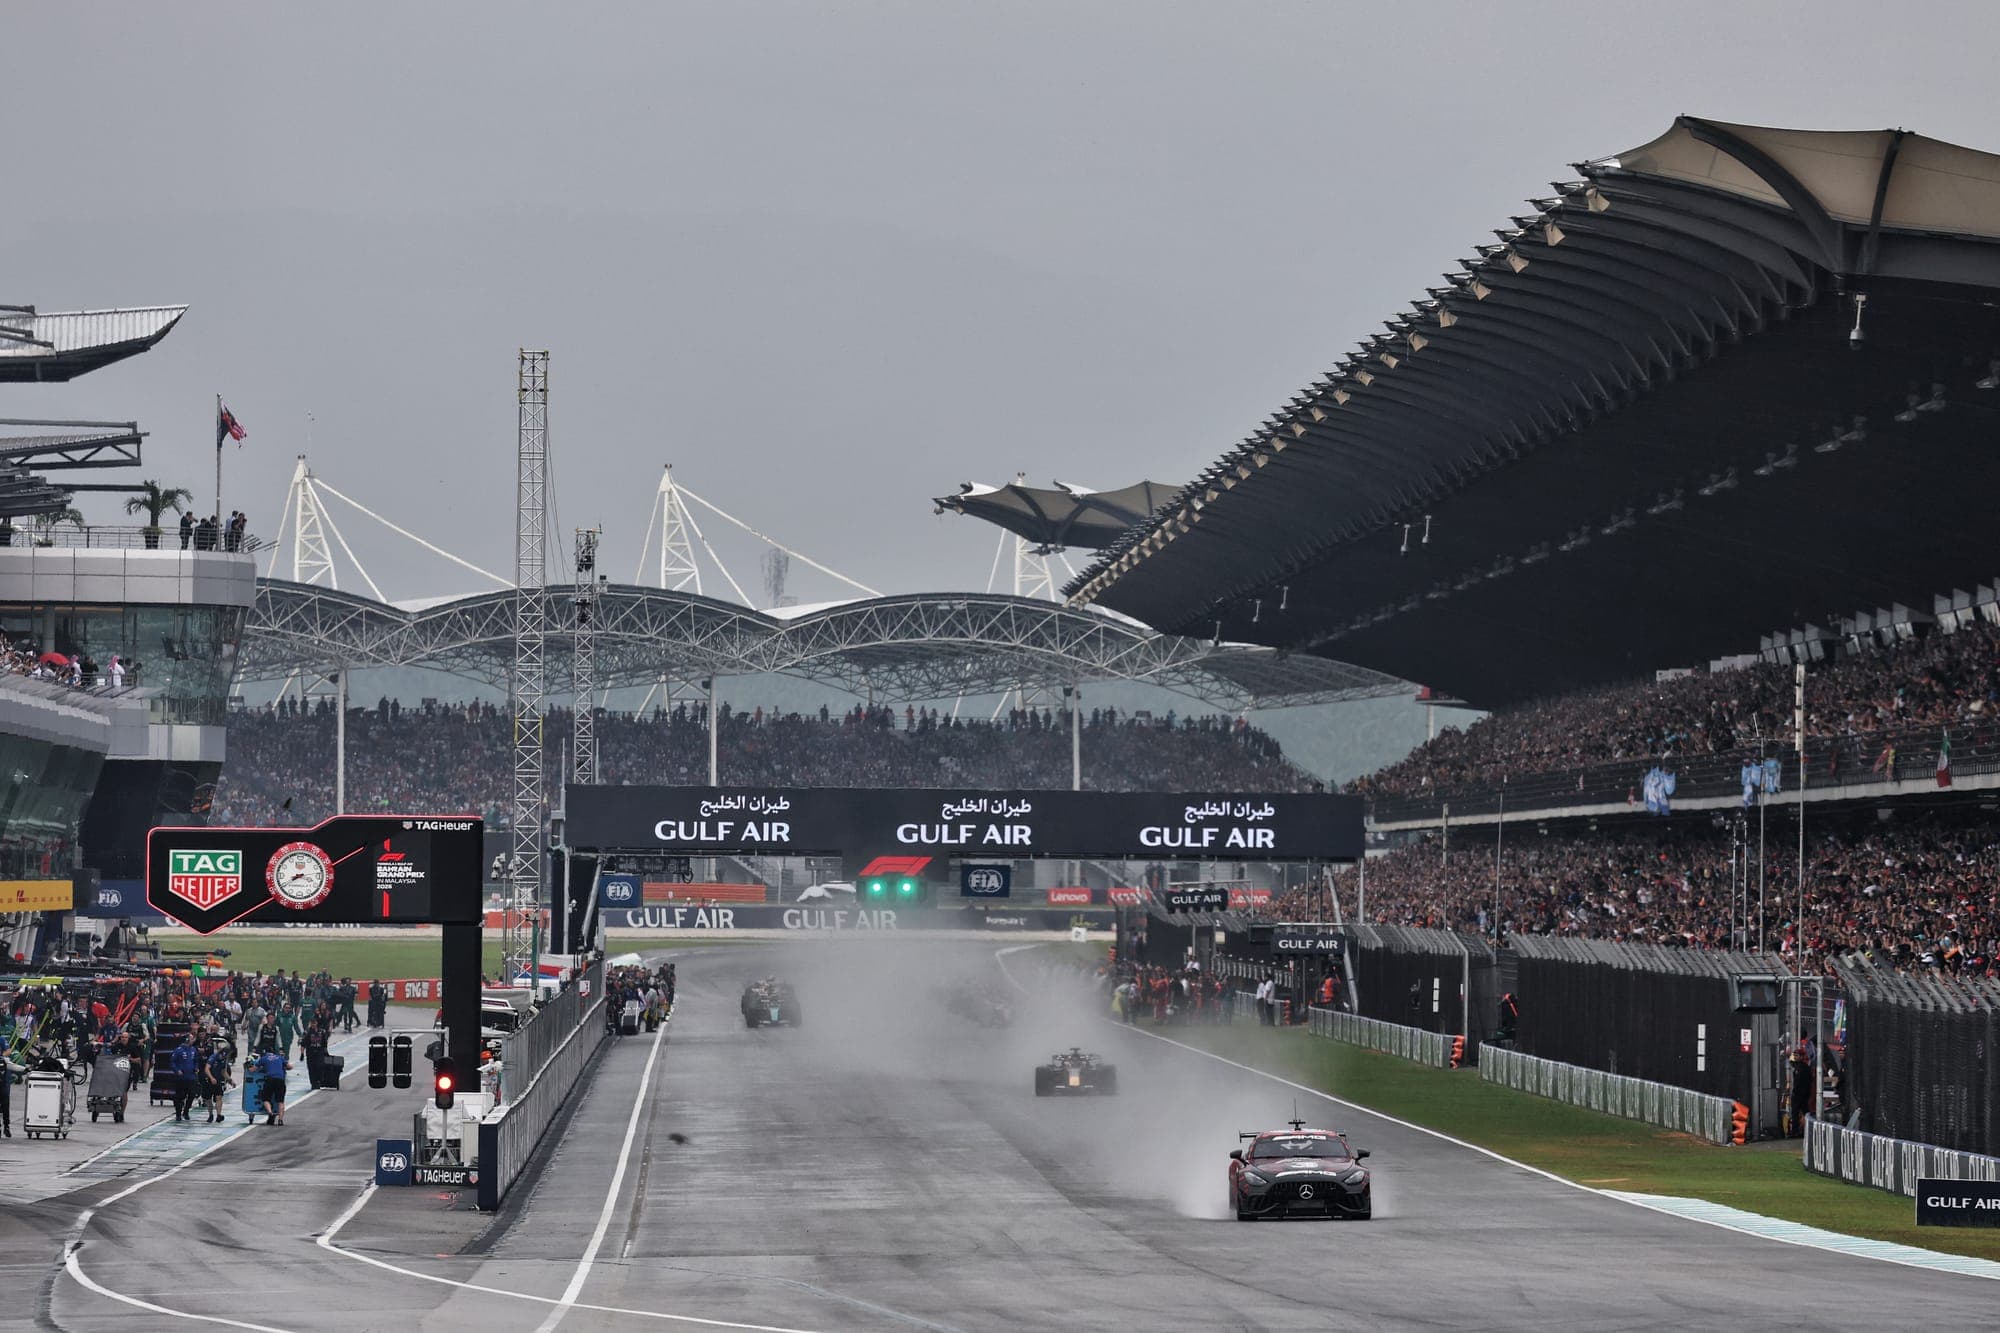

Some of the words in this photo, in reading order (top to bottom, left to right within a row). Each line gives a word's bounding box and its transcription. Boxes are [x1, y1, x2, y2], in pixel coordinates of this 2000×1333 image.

[700, 795, 746, 817] الخليج
[749, 796, 791, 815] طيران
[941, 798, 988, 820] الخليج
[990, 798, 1032, 818] طيران
[1184, 801, 1231, 824] الخليج
[1233, 802, 1276, 821] طيران
[654, 820, 735, 841] GULF
[741, 821, 791, 842] AIR
[896, 823, 977, 844] GULF
[982, 823, 1032, 846] AIR
[1139, 826, 1220, 848] GULF
[1225, 827, 1276, 849] AIR
[175, 854, 236, 873] TAG
[173, 877, 238, 905] HEUER
[1051, 892, 1089, 902] Lenovo
[1171, 895, 1202, 905] GULF
[1203, 893, 1223, 903] AIR
[626, 907, 687, 929] GULF
[694, 908, 735, 930] AIR
[783, 908, 848, 930] GULF
[857, 909, 897, 931] AIR
[1278, 939, 1314, 949] GULF
[1315, 939, 1338, 950] AIR
[382, 1156, 405, 1168] FIA
[1926, 1196, 1972, 1209] GULF
[1974, 1198, 2000, 1210] AIR
